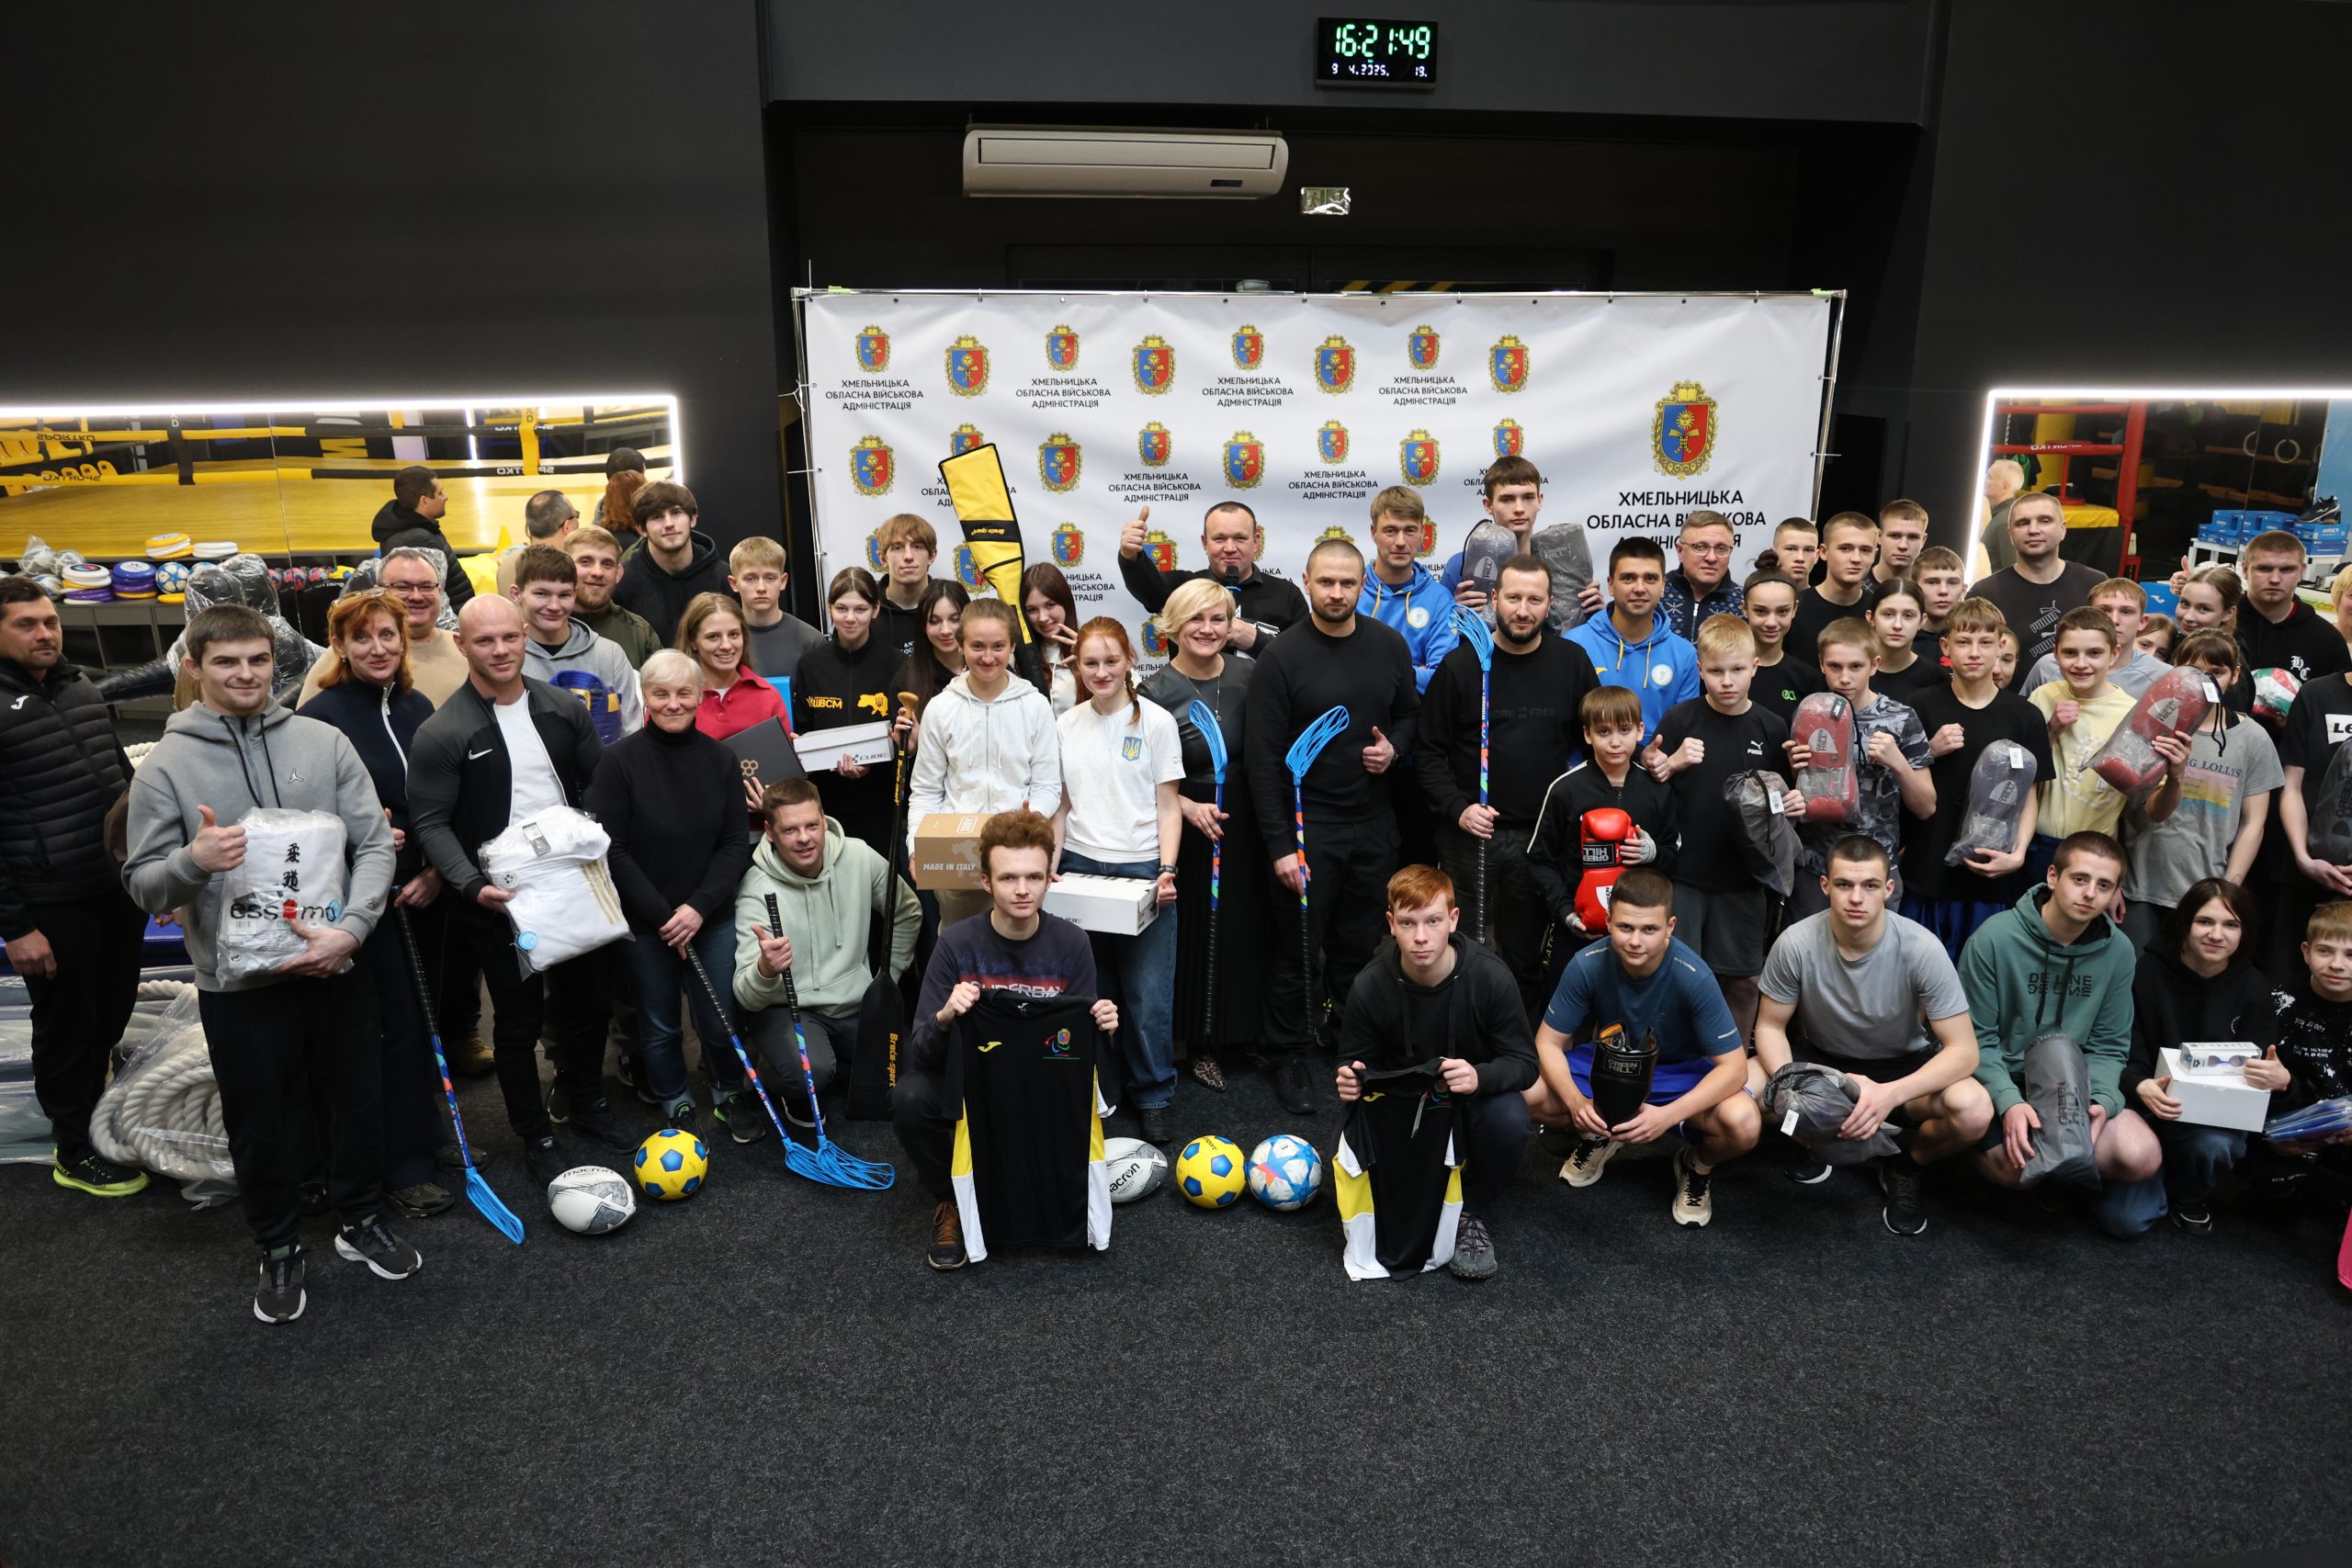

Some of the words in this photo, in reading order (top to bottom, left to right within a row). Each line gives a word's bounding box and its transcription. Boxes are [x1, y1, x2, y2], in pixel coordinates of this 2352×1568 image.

[841, 379, 910, 389] ХМЕЛЬНИЦЬКА
[1031, 378, 1098, 388] ХМЕЛЬНИЦЬКА
[1217, 377, 1281, 386] ХМЕЛЬНИЦЬКА
[1394, 376, 1455, 385] ХМЕЛЬНИЦЬКА
[825, 390, 872, 400] ОБЛАСНА
[873, 389, 924, 399] ВІЙСЬКОВА
[1015, 389, 1060, 398] ОБЛАСНА
[1061, 388, 1112, 397] ВІЙСЬКОВА
[1202, 388, 1245, 396] ОБЛАСНА
[1246, 386, 1295, 396] ВІЙСЬКОВА
[1378, 387, 1420, 395] ОБЛАСНА
[1421, 385, 1468, 395] ВІЙСЬКОВА
[842, 401, 911, 412] АДМІНІСТРАЦІЯ
[1031, 400, 1099, 410] АДМІНІСТРАЦІЯ
[1216, 398, 1282, 408] АДМІНІСТРАЦІЯ
[1393, 397, 1456, 407] АДМІНІСТРАЦІЯ
[1124, 472, 1189, 482] ХМЕЛЬНИЦЬКА
[1304, 470, 1366, 479] ХМЕЛЬНИЦЬКА
[1108, 483, 1152, 492] ОБЛАСНА
[1153, 481, 1202, 491] ВІЙСЬКОВА
[1288, 481, 1330, 490] ОБЛАСНА
[1331, 479, 1379, 489] ВІЙСЬКОВА
[1124, 492, 1189, 503] АДМІНІСТРАЦІЯ
[1302, 491, 1366, 501] АДМІНІСТРАЦІЯ
[1618, 490, 1744, 507] ХМЕЛЬНИЦЬКА
[1587, 513, 1670, 530] ОБЛАСНА
[1675, 512, 1766, 528] ВІКОВА
[1066, 573, 1102, 582] НИЦЬКА
[2030, 611, 2058, 633] PUMA
[2202, 761, 2242, 778] LOLLYS
[922, 863, 944, 871] MADE
[945, 863, 955, 871] IN
[956, 863, 977, 871] ITALY
[563, 1168, 614, 1179] macron
